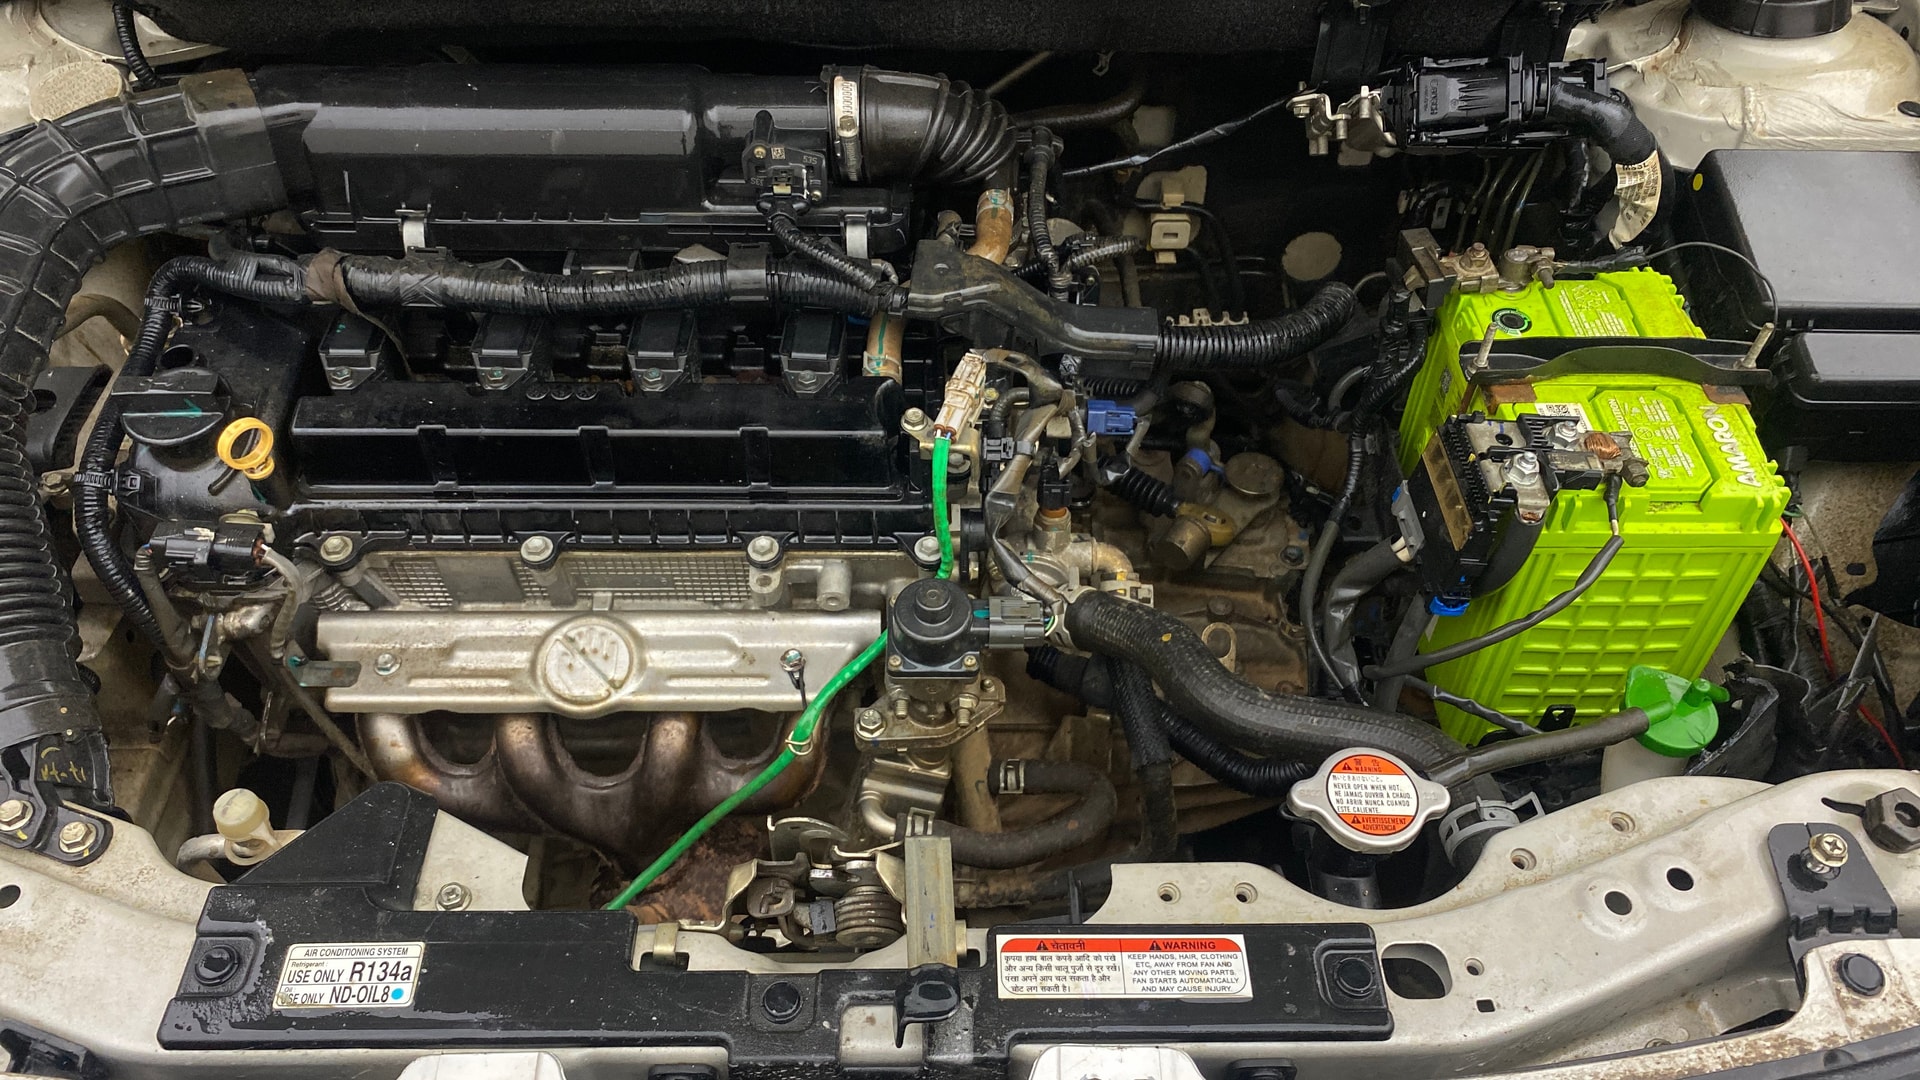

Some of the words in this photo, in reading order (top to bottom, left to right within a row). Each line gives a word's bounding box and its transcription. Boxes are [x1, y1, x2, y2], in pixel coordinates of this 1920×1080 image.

[1698, 404, 1762, 487] AMARON
[304, 949, 318, 957] AIR
[320, 948, 375, 956] CONDITIONING
[377, 947, 408, 956] SYSTEM
[1051, 939, 1086, 951] चेतावनी
[1162, 941, 1216, 950] WARNING
[287, 970, 311, 983] USE
[314, 969, 344, 983] ONLY
[349, 961, 412, 982] R134a
[281, 993, 298, 1004] USE
[301, 993, 325, 1004] ONLY
[329, 985, 390, 1004] ND-OIL8
